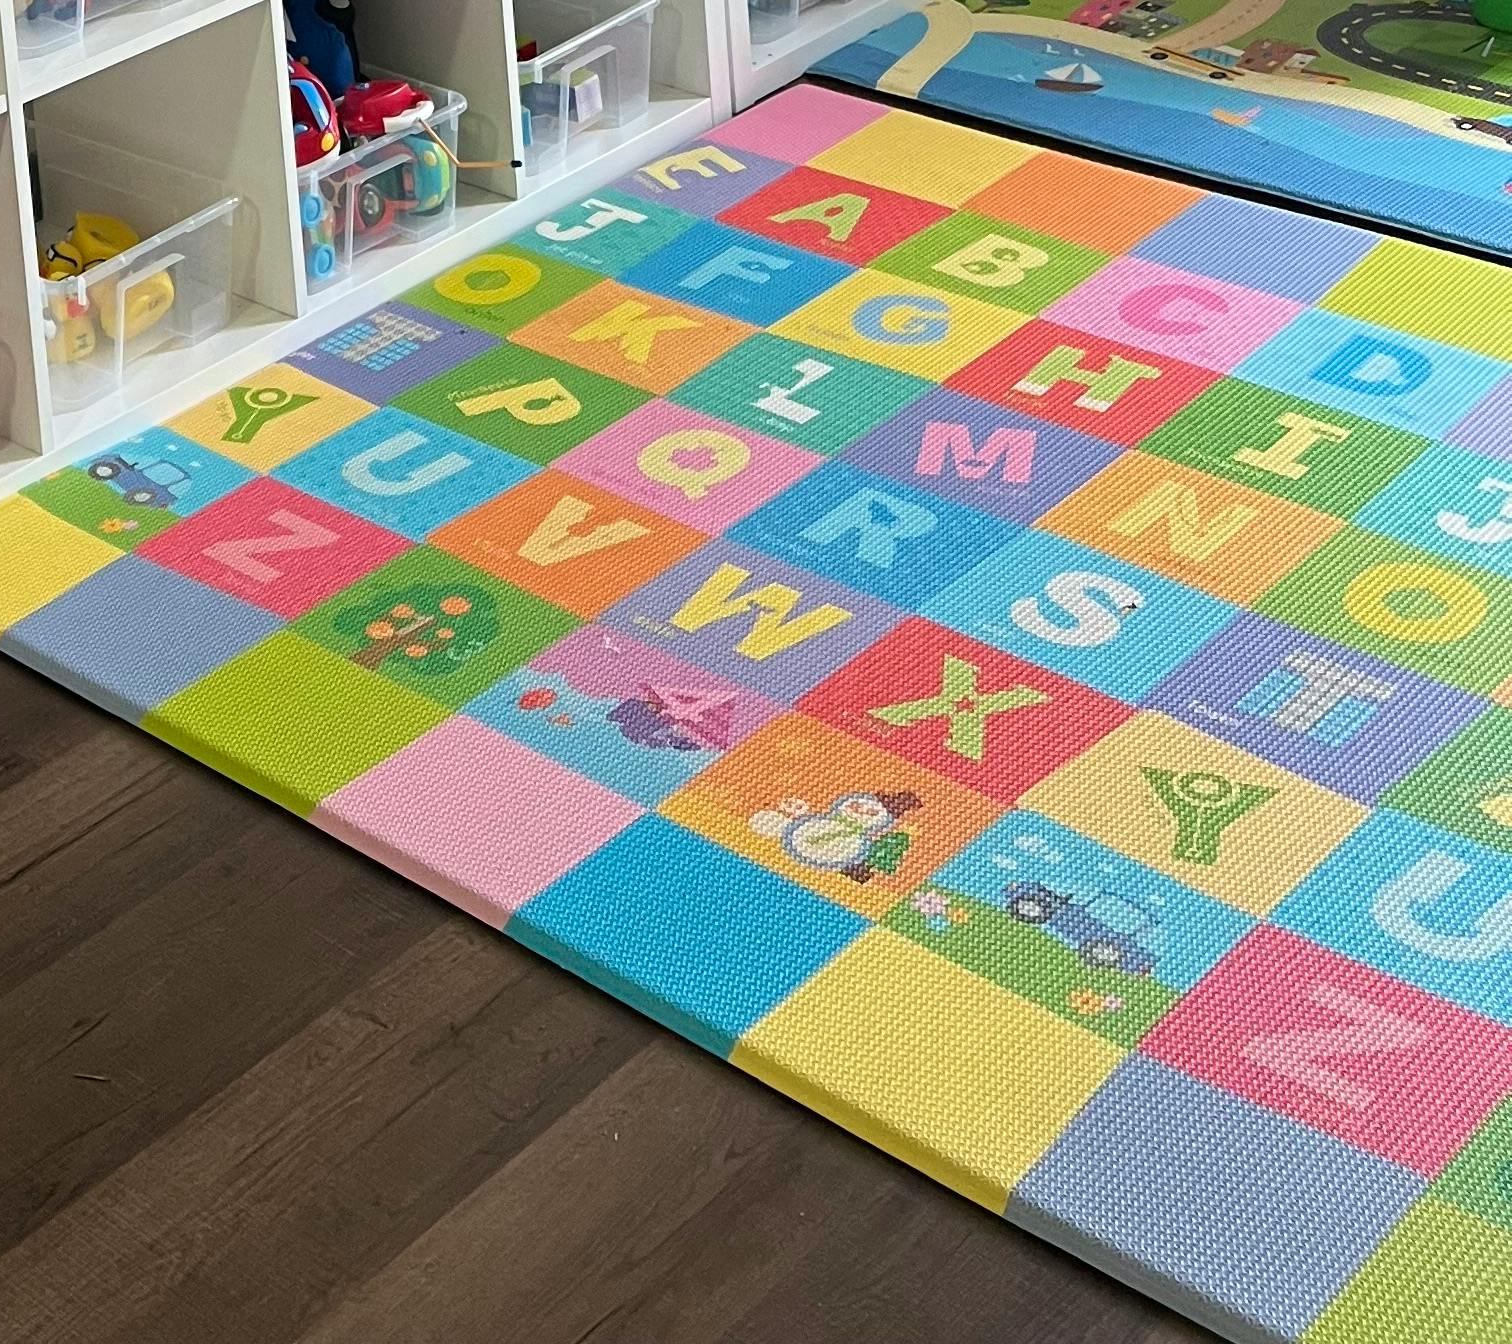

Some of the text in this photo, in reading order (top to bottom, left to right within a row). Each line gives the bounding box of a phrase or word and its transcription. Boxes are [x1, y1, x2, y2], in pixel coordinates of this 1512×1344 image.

[638, 145, 747, 191] E
[536, 199, 649, 242] J
[767, 193, 871, 243] A
[433, 253, 541, 305] O
[679, 246, 795, 291] F
[934, 229, 1051, 289] B
[317, 311, 442, 372] T
[568, 301, 702, 367] K
[850, 294, 952, 346] G
[1119, 282, 1230, 338] C
[1013, 345, 1163, 412] H
[1310, 333, 1435, 397] D
[454, 377, 582, 426] P
[341, 429, 471, 498] U
[636, 428, 752, 501] Q
[913, 421, 1038, 484] M
[1233, 412, 1353, 480] I
[203, 508, 345, 585] Z
[518, 493, 651, 567] V
[799, 487, 938, 569] R
[1107, 481, 1260, 561] N
[671, 561, 852, 662] W
[1009, 569, 1147, 649] S
[1341, 562, 1490, 645] O
[865, 653, 1054, 762] X
[1230, 650, 1396, 748] T
[1138, 764, 1283, 866] Y
[1240, 983, 1431, 1108] Z
